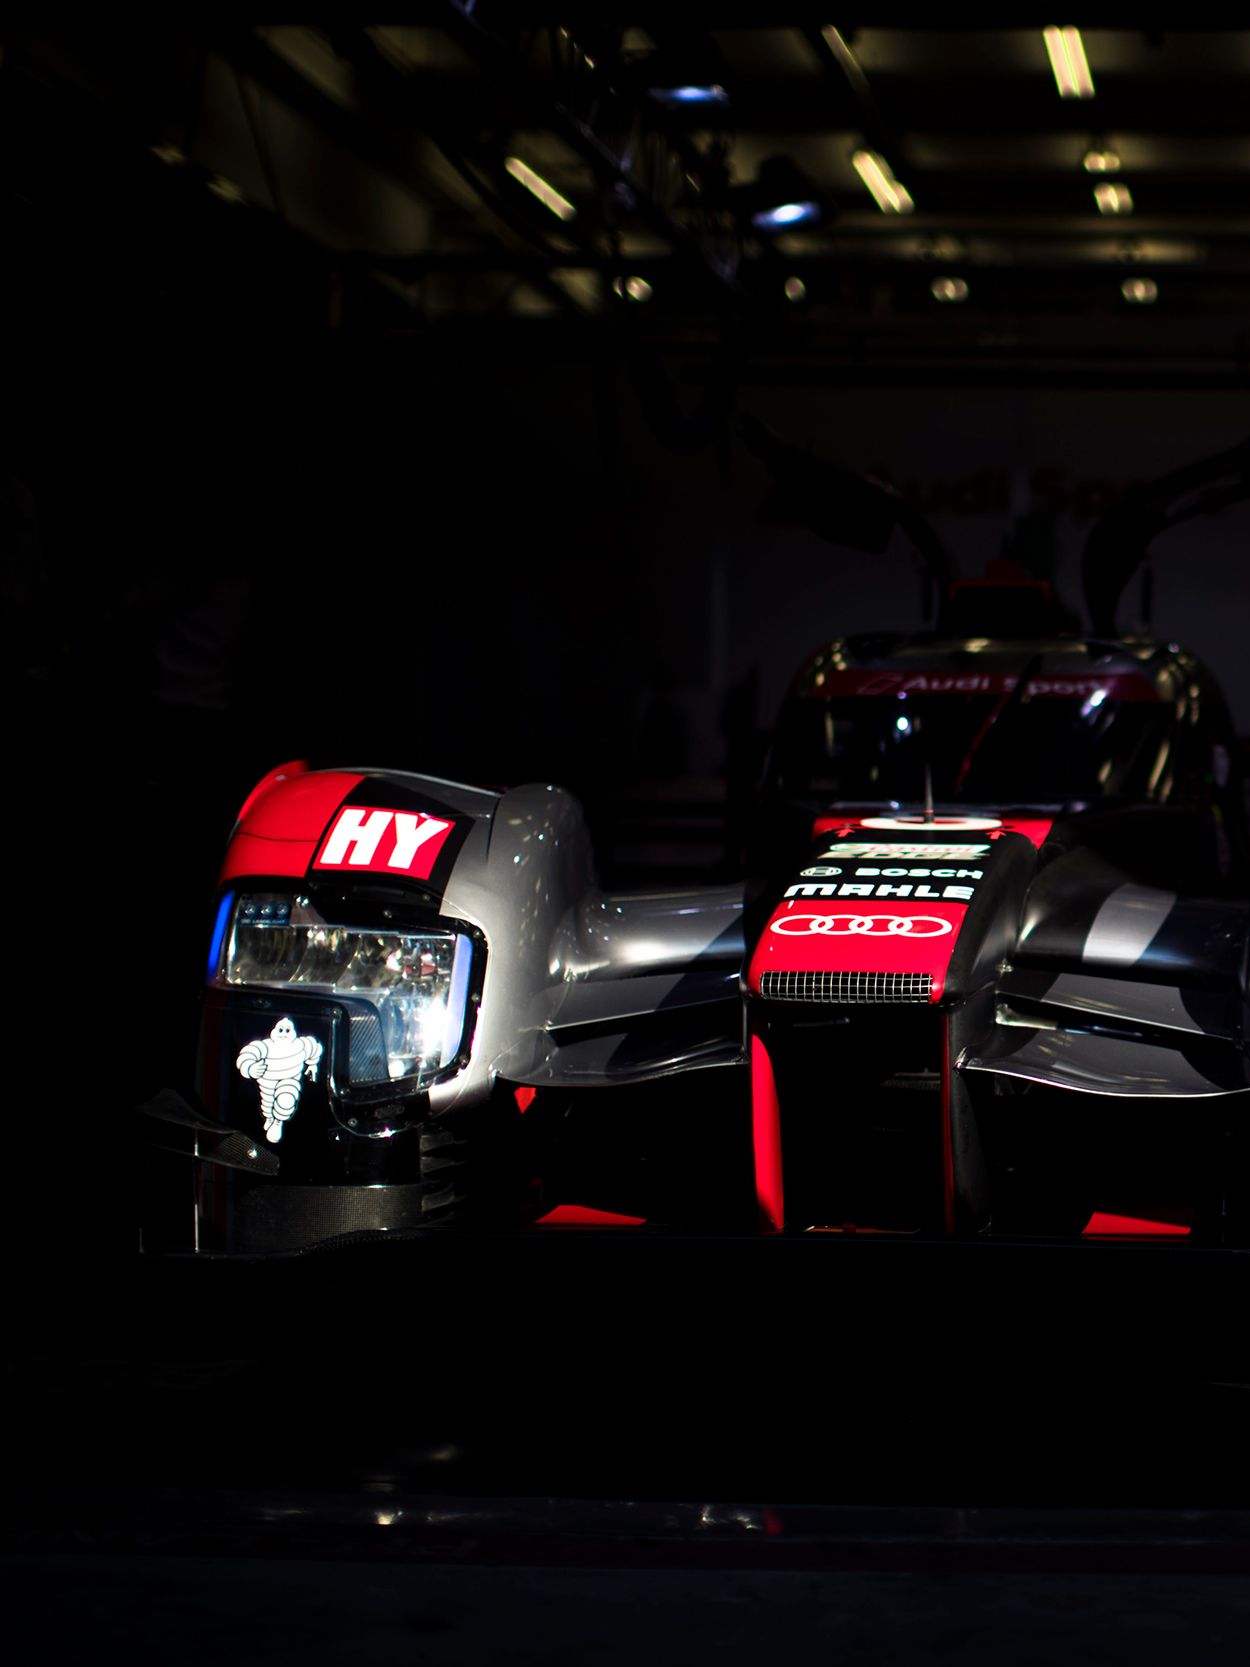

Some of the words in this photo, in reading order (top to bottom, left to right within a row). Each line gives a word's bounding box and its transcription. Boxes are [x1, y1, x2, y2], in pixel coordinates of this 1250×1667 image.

[863, 464, 1010, 516] udi
[902, 676, 990, 691] Audi
[320, 808, 449, 869] HY
[817, 851, 989, 861] EDGE
[855, 867, 984, 880] BOSCH
[784, 883, 975, 900] MAHLE
